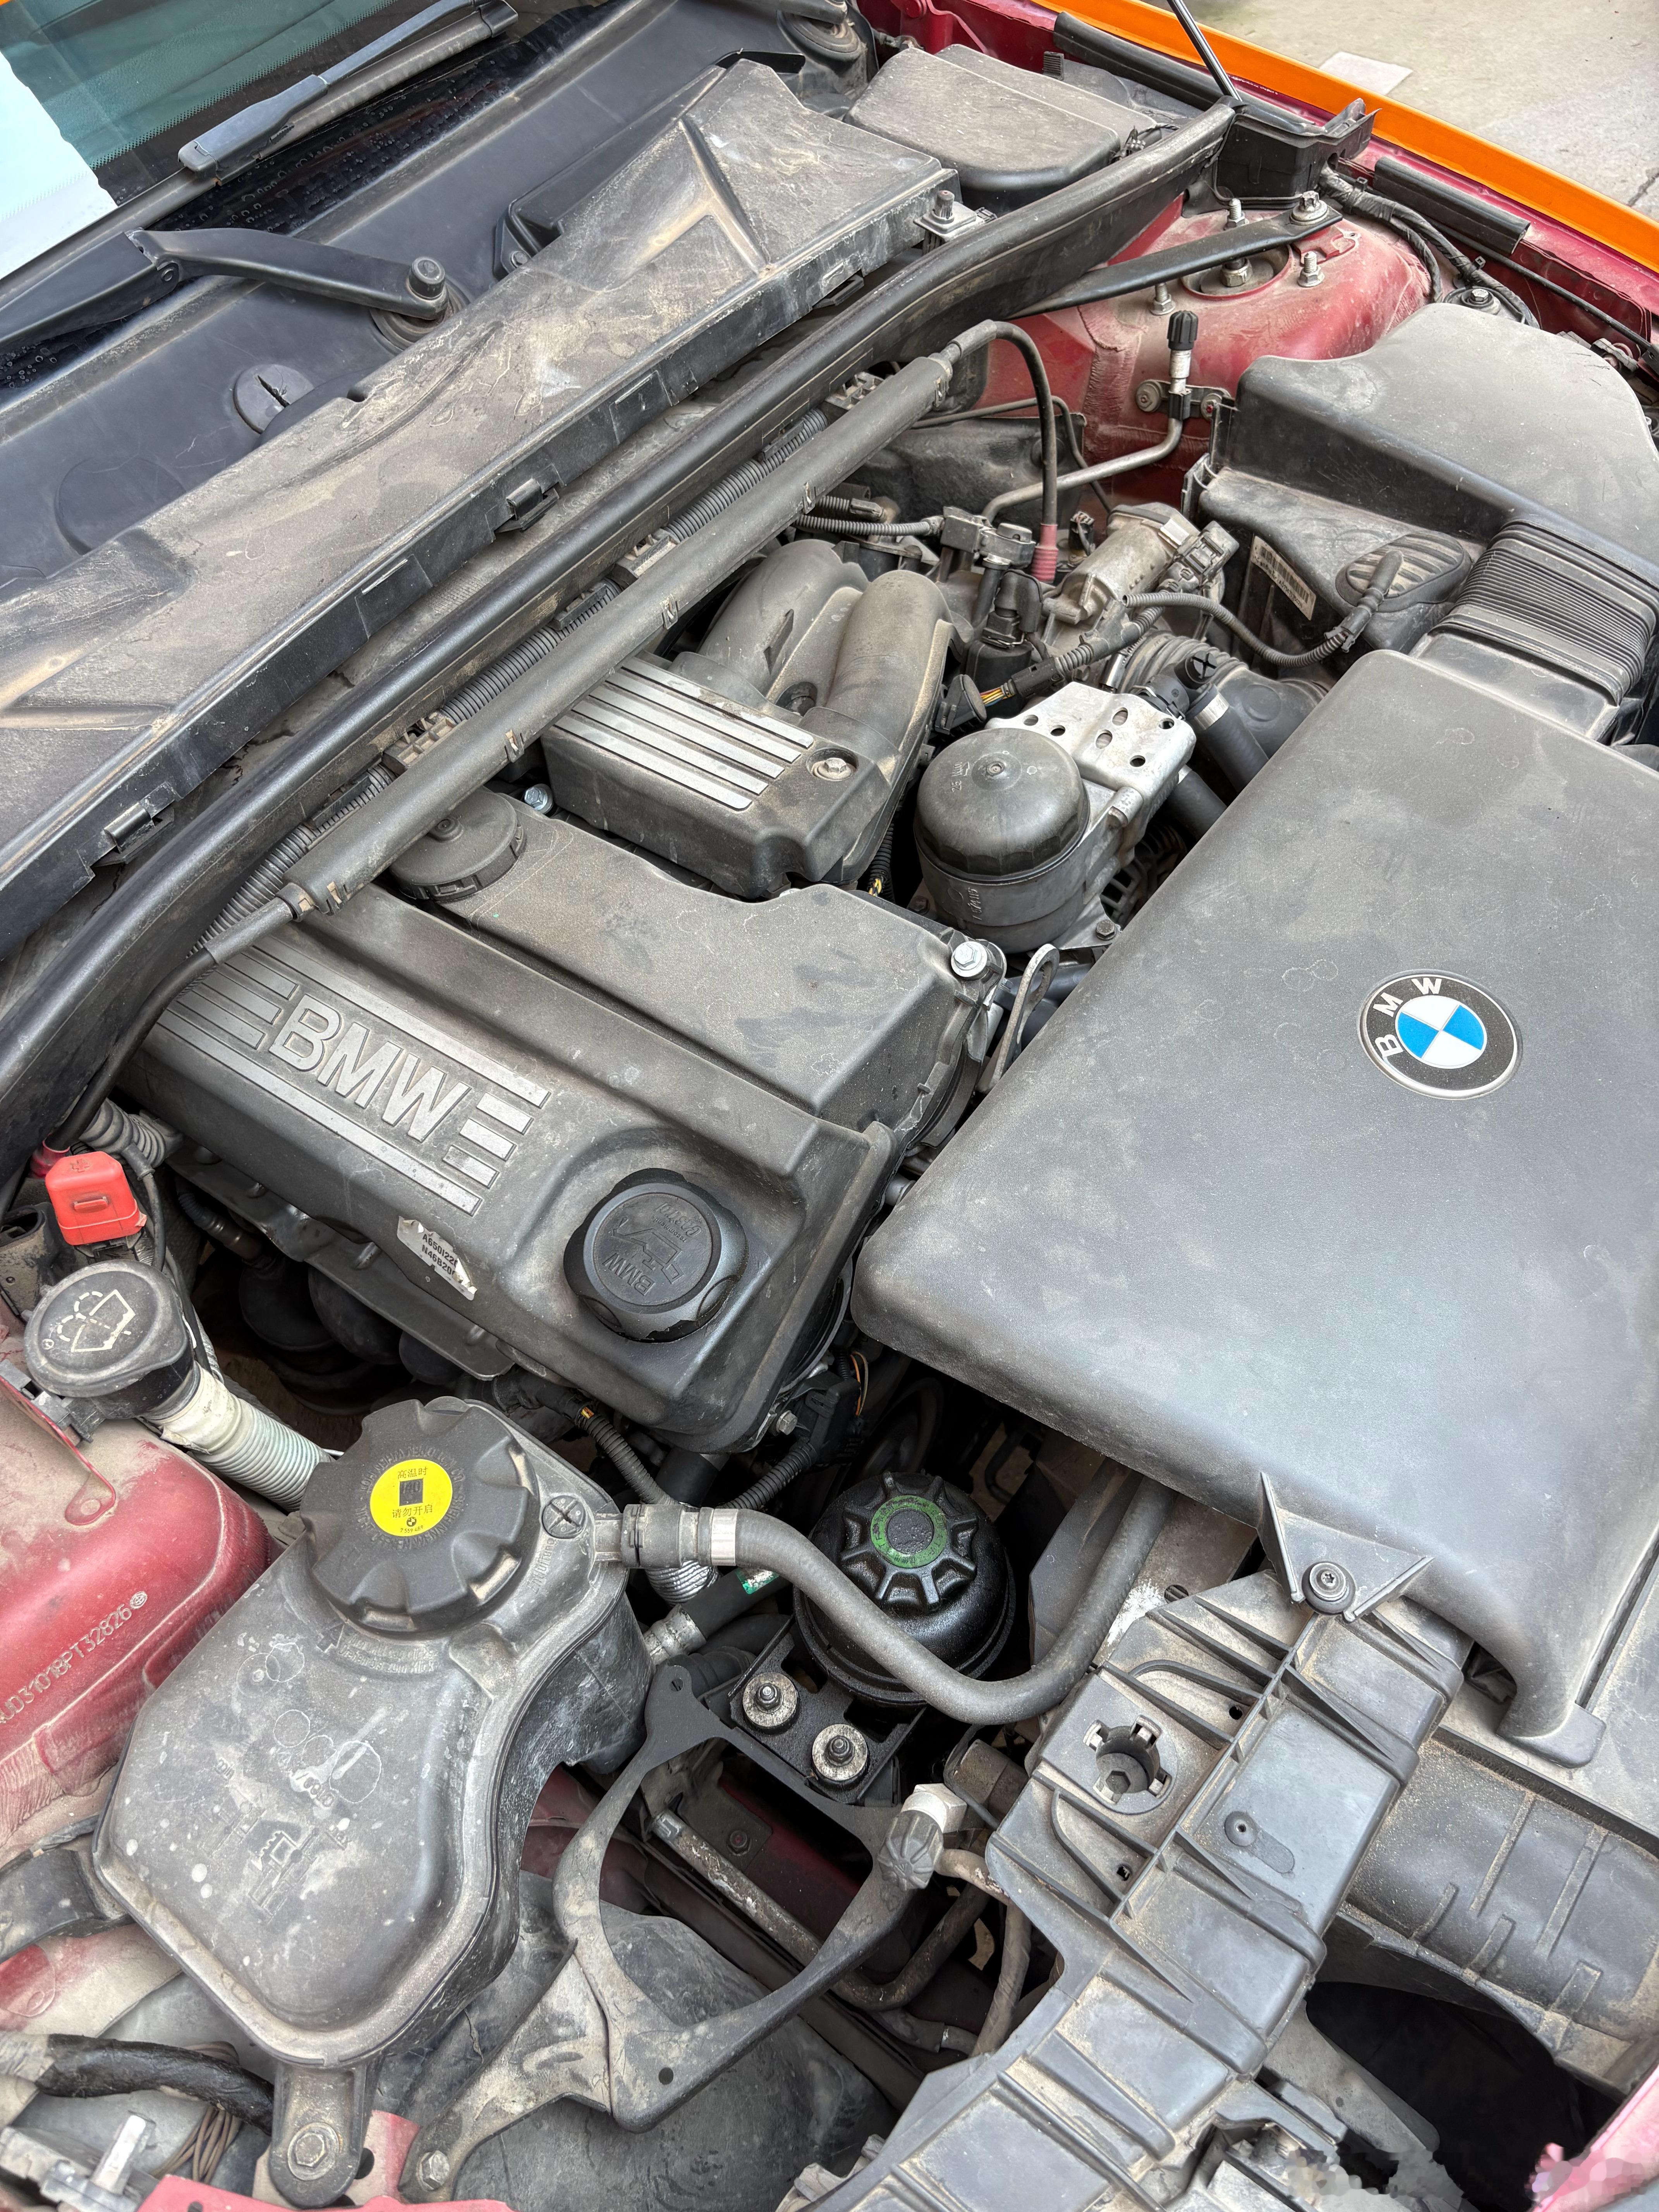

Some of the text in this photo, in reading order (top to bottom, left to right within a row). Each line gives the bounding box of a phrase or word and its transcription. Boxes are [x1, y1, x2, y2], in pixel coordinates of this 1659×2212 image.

[951, 780, 962, 792] 25
[1373, 977, 1443, 1058] BMW
[269, 993, 472, 1143] BMW
[655, 1202, 703, 1238] Castrol
[602, 1252, 656, 1296] BMW
[397, 1466, 428, 1480] 高温时
[392, 1504, 433, 1518] 请勿开启
